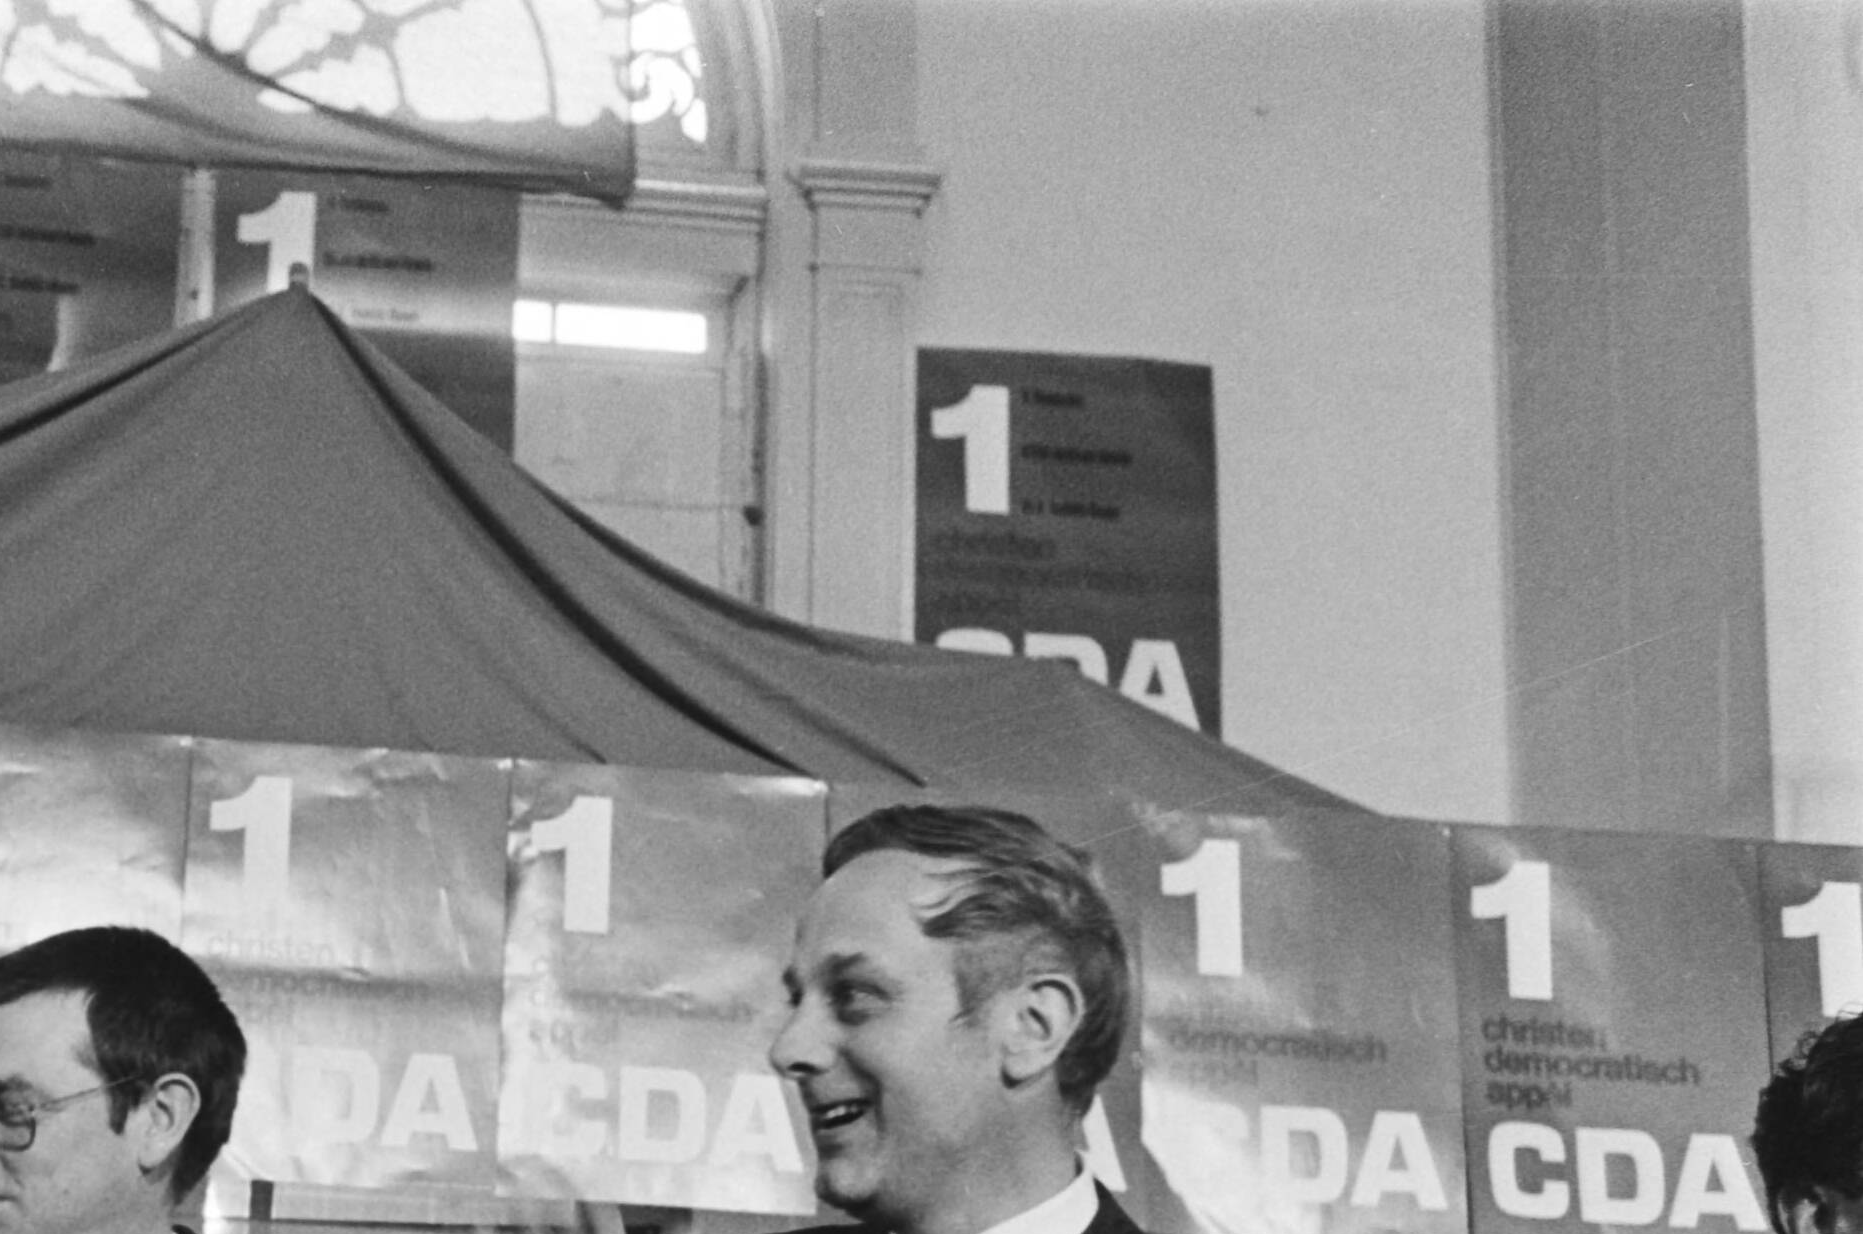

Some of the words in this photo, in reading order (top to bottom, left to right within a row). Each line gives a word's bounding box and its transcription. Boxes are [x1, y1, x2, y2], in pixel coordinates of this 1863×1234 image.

[238, 192, 317, 294] 1
[931, 385, 1010, 515] 1
[210, 776, 292, 910] 1
[531, 796, 613, 934] 1
[1160, 839, 1243, 977] 1
[1471, 861, 1553, 1000] 1
[1781, 881, 1863, 1018] 1
[1484, 1043, 1701, 1086] democratisch
[1487, 1121, 1770, 1233] CDA
